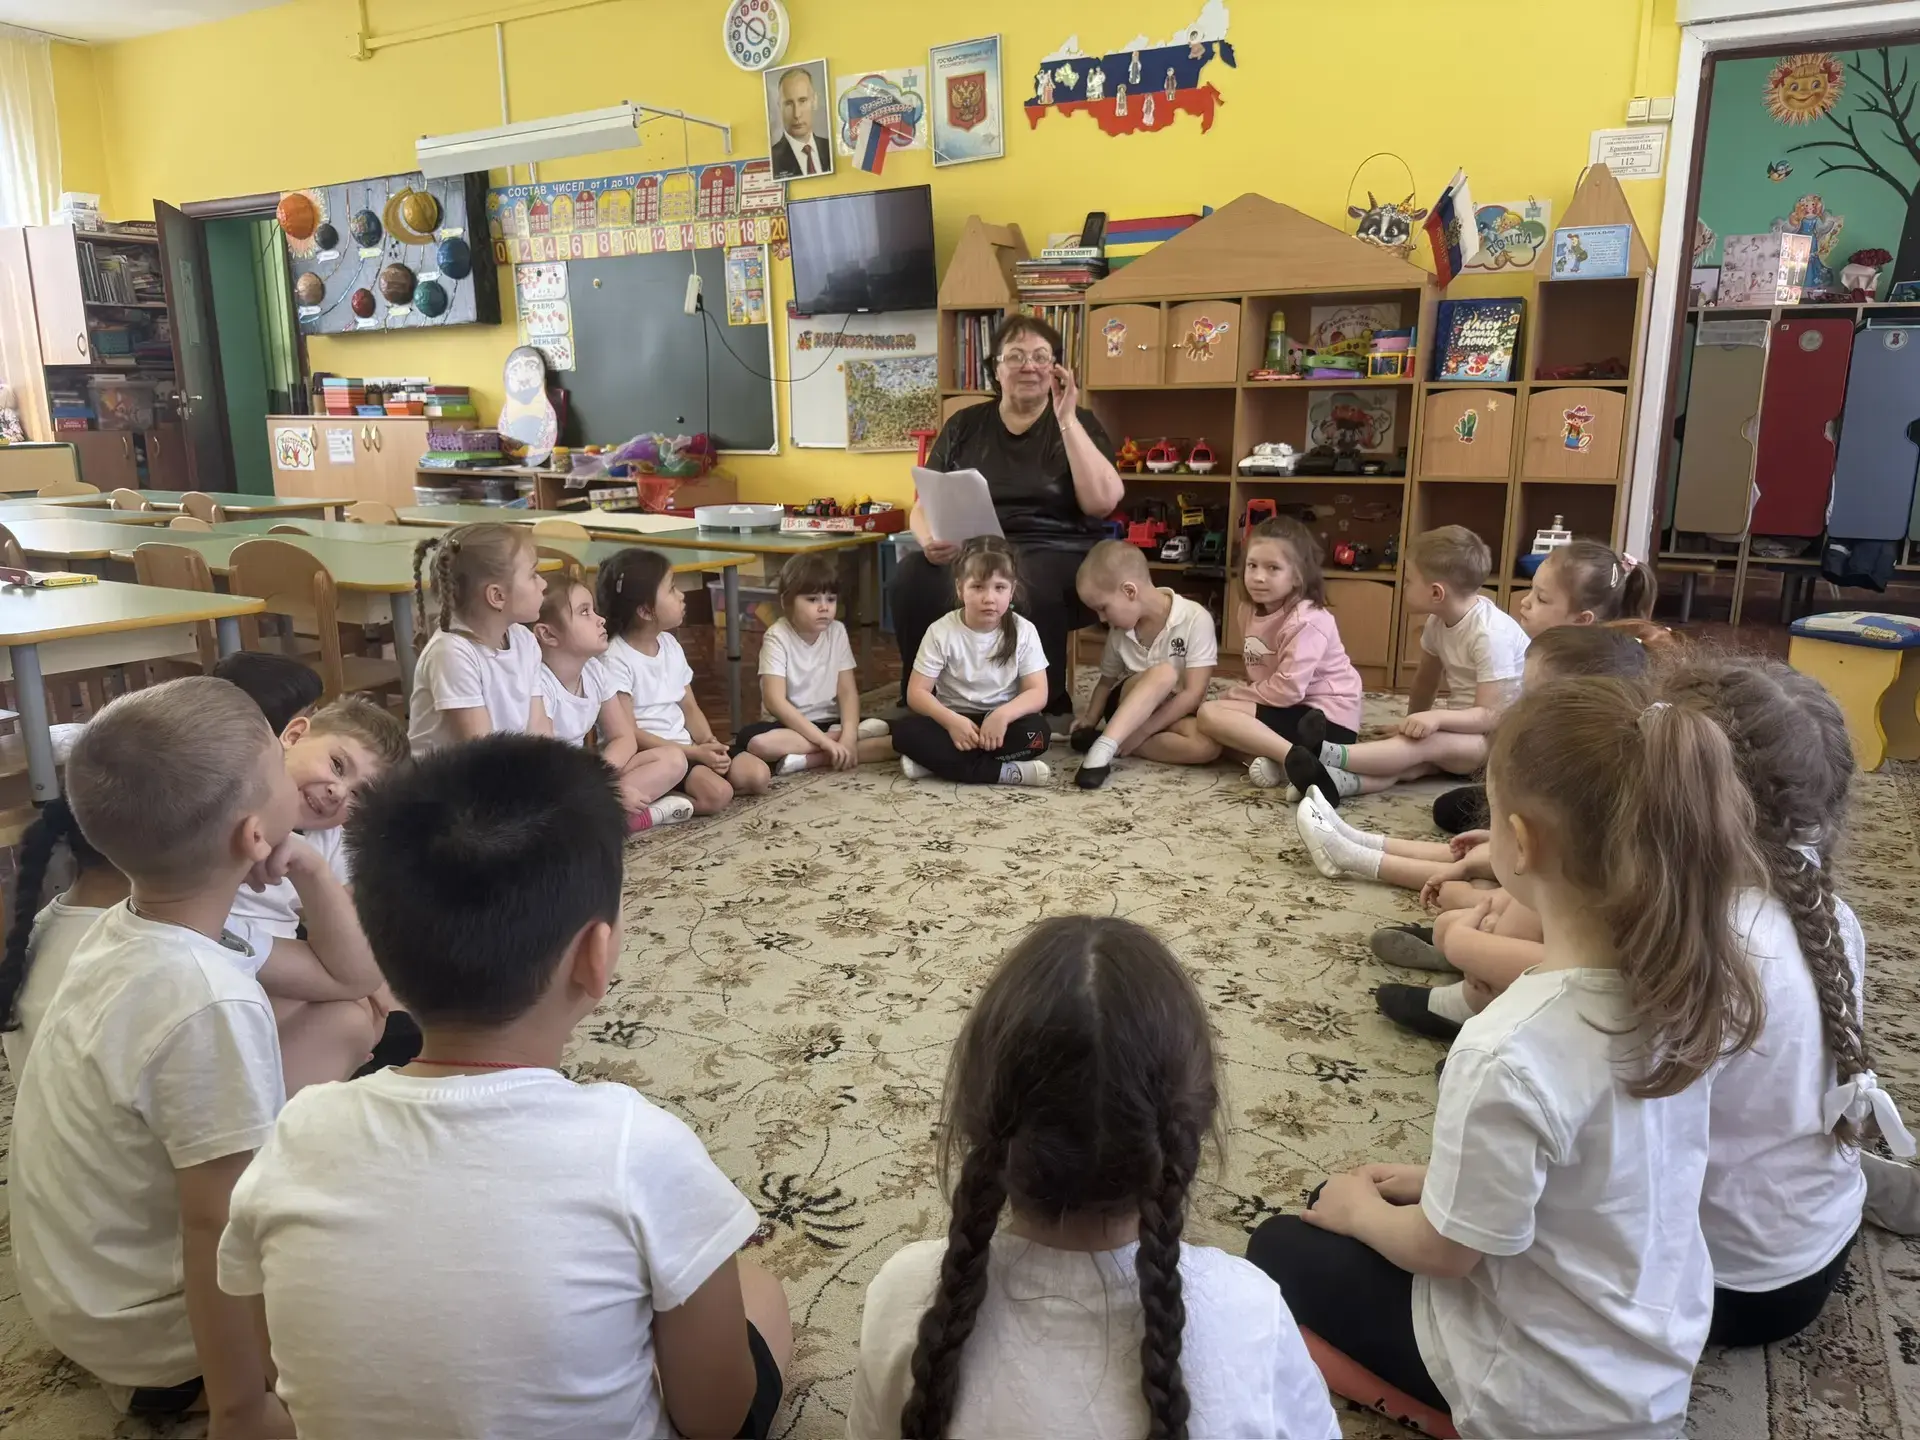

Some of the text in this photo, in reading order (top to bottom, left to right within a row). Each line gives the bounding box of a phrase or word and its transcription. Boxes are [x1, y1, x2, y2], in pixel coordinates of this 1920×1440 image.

[1620, 157, 1634, 166] 112
[508, 176, 634, 198] СОСТАВ ЧИСЕЛ от 1 до 10
[522, 241, 530, 260] 2
[546, 238, 555, 258] 4
[572, 236, 582, 254] 6
[600, 234, 610, 254] 8
[624, 231, 636, 252] 10
[652, 228, 666, 250] 12
[682, 226, 694, 248] 14
[711, 222, 724, 245] 16
[741, 220, 754, 242] 18
[756, 219, 770, 240] 19
[772, 218, 786, 240] 20
[1486, 232, 1532, 258] ПОЧТА
[532, 302, 555, 310] РАВНО
[1472, 320, 1502, 330] ЛЕСУ
[533, 337, 561, 345] МЕНЬШЕ
